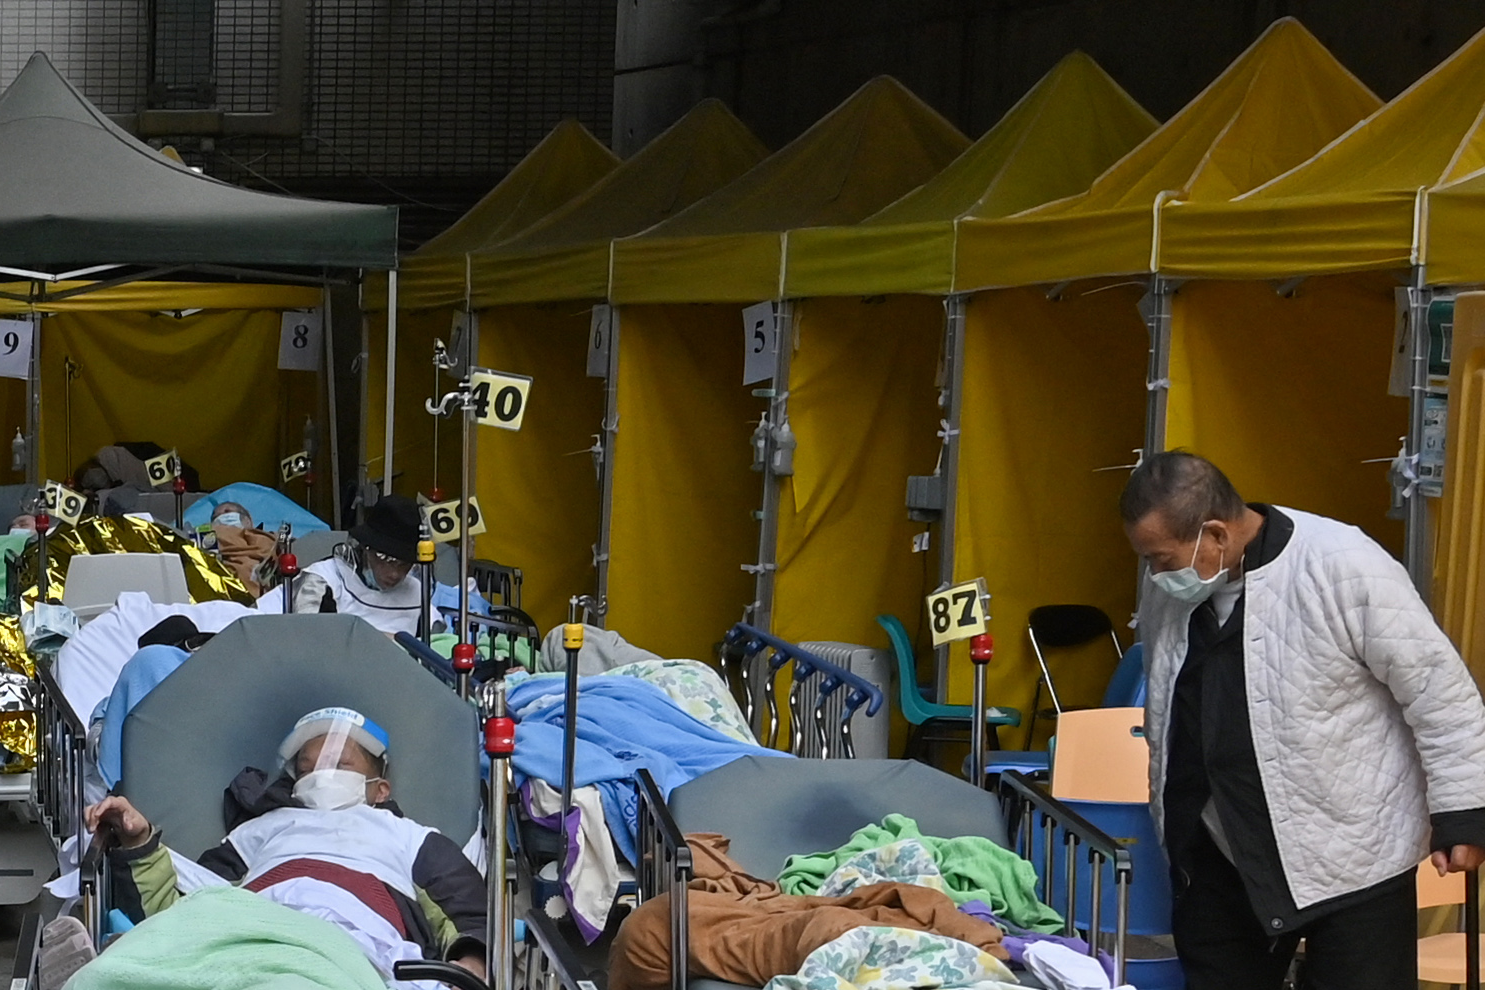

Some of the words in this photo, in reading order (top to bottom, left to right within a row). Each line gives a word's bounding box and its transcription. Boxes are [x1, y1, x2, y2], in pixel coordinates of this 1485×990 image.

[3, 331, 19, 355] 9
[292, 324, 309, 349] 8
[595, 321, 602, 350] 6
[754, 320, 765, 353] 5
[471, 381, 523, 422] 40
[148, 455, 175, 480] 60
[43, 487, 82, 517] 39
[430, 503, 479, 534] 69
[931, 590, 978, 634] 87
